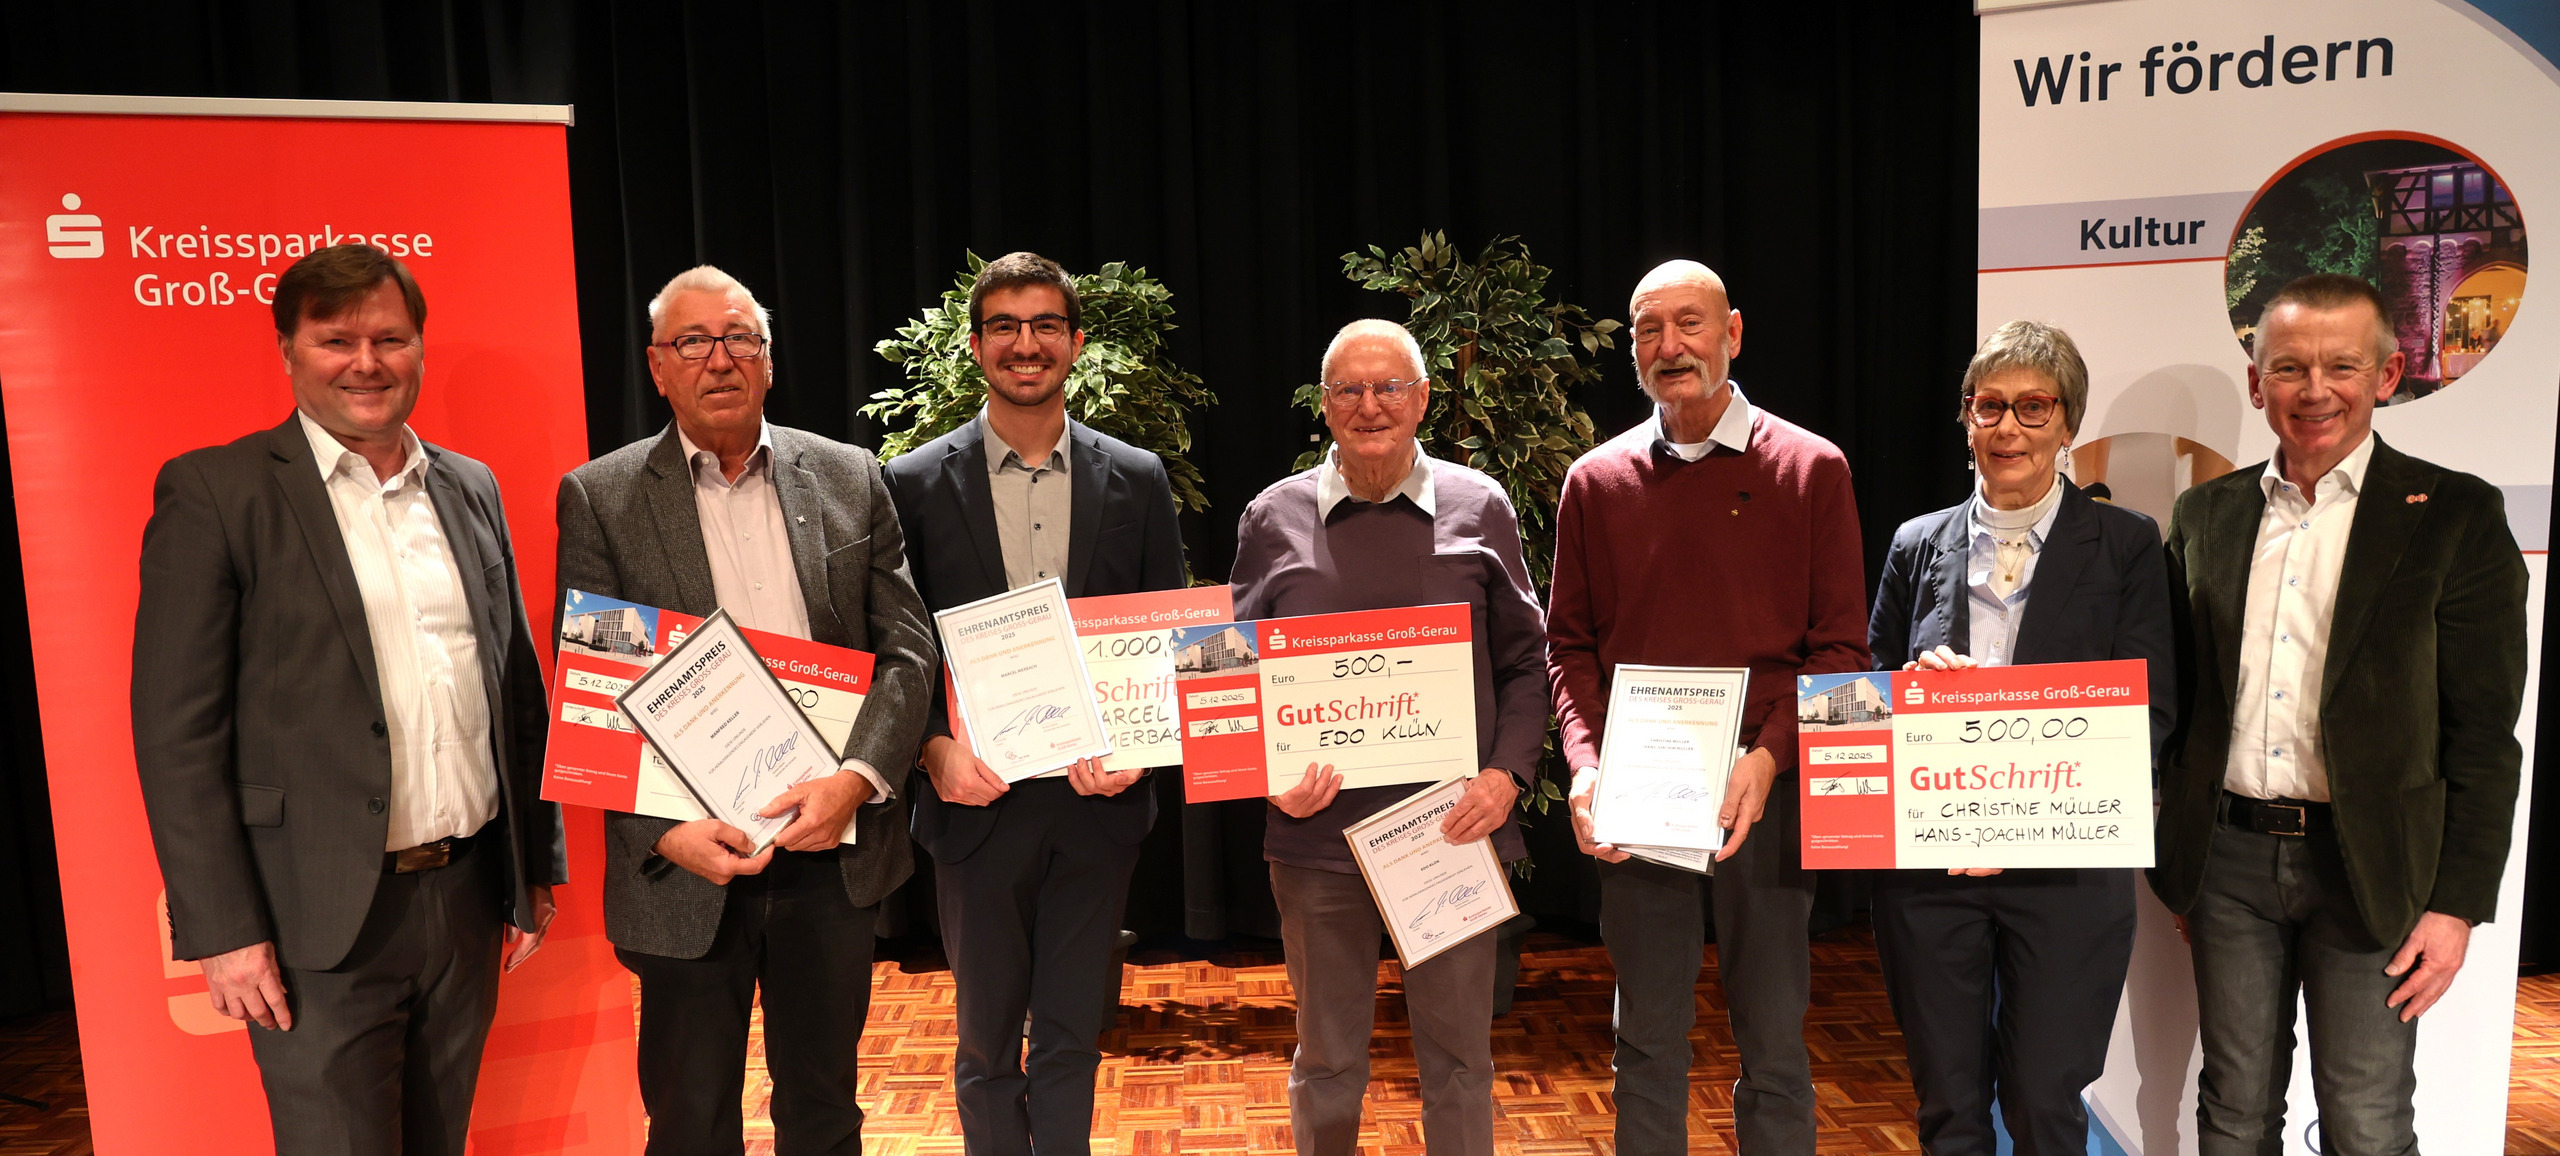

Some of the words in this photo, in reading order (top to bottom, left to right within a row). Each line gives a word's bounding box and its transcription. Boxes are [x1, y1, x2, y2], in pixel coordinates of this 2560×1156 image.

[2014, 52, 2122, 107] Wir
[2140, 35, 2393, 97] fördern
[2081, 217, 2205, 250] Kultur
[134, 272, 276, 306] Groß-G
[957, 603, 1050, 637] EHRENAMTSPREIS
[960, 635, 975, 644] DES
[975, 627, 1003, 640] KREISES
[1002, 613, 1052, 632] GROSS-GERAU
[1073, 615, 1147, 629] eissparkasse
[1151, 608, 1219, 622] Groß-Gerau
[1001, 632, 1016, 640] 2025
[1293, 632, 1383, 648] Kreissparkasse
[1387, 626, 1457, 639] Groß-Gerau
[646, 639, 727, 715] EHRENAMTSPREIS
[790, 660, 858, 684] Groß-Gerau
[1272, 675, 1294, 684] Euro
[653, 707, 669, 722] DES
[666, 686, 692, 711] KREISES
[689, 648, 732, 690] GROSS-GERAU
[692, 685, 706, 699] 2025
[1095, 675, 1178, 703] Schrift
[1631, 687, 1726, 697] EHRENAMTSPREIS
[1932, 689, 2039, 704] Kreissparkasse
[2044, 685, 2129, 699] Groß-Gerau
[673, 728, 685, 740] ALS
[683, 715, 699, 731] DANK
[697, 705, 710, 718] UND
[708, 671, 745, 708] ANERKENNUNG
[1102, 705, 1169, 725] ARCEL
[1109, 728, 1181, 747] ERBAC
[1320, 729, 1364, 747] EDO
[1383, 719, 1441, 739] KLÜN
[1907, 733, 1932, 742] Euro
[1960, 717, 2088, 745] 500,00
[1277, 743, 1290, 751] für
[1908, 809, 1924, 818] für
[1941, 798, 2040, 818] CHRISTINE
[2051, 797, 2121, 815] MÜLLER
[1369, 799, 1455, 848] EHRENAMTSPREIS
[1915, 827, 2043, 847] HANS-JOACHIM
[2052, 822, 2119, 840] MÜLLER
[1372, 843, 1386, 854] DES
[1386, 830, 1412, 847] KREISES
[1411, 832, 1425, 841] 2025
[1383, 861, 1394, 869] ALS
[1393, 853, 1409, 864] DANK
[1409, 847, 1422, 856] UND
